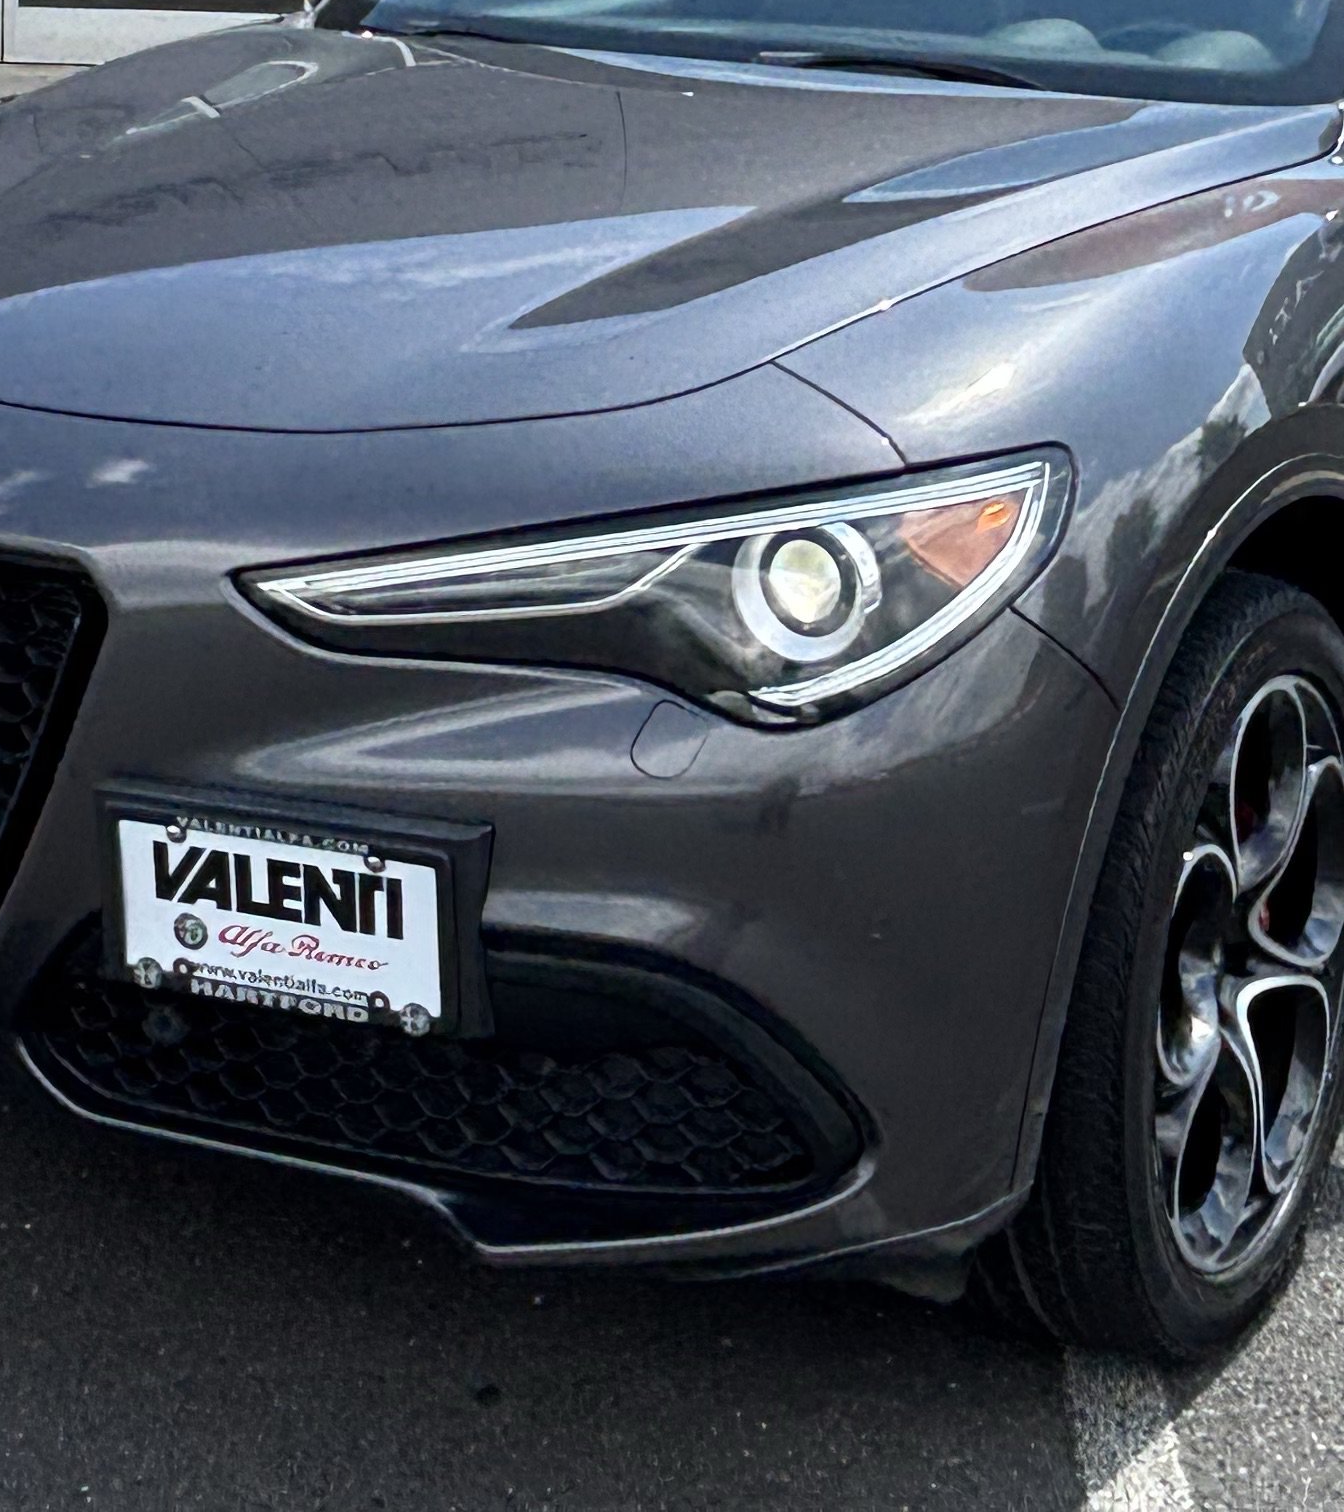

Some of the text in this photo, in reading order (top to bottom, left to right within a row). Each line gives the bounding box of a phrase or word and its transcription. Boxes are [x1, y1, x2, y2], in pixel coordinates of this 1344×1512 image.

[152, 840, 404, 940] VALENTI
[218, 924, 389, 970] Alfa Romeo
